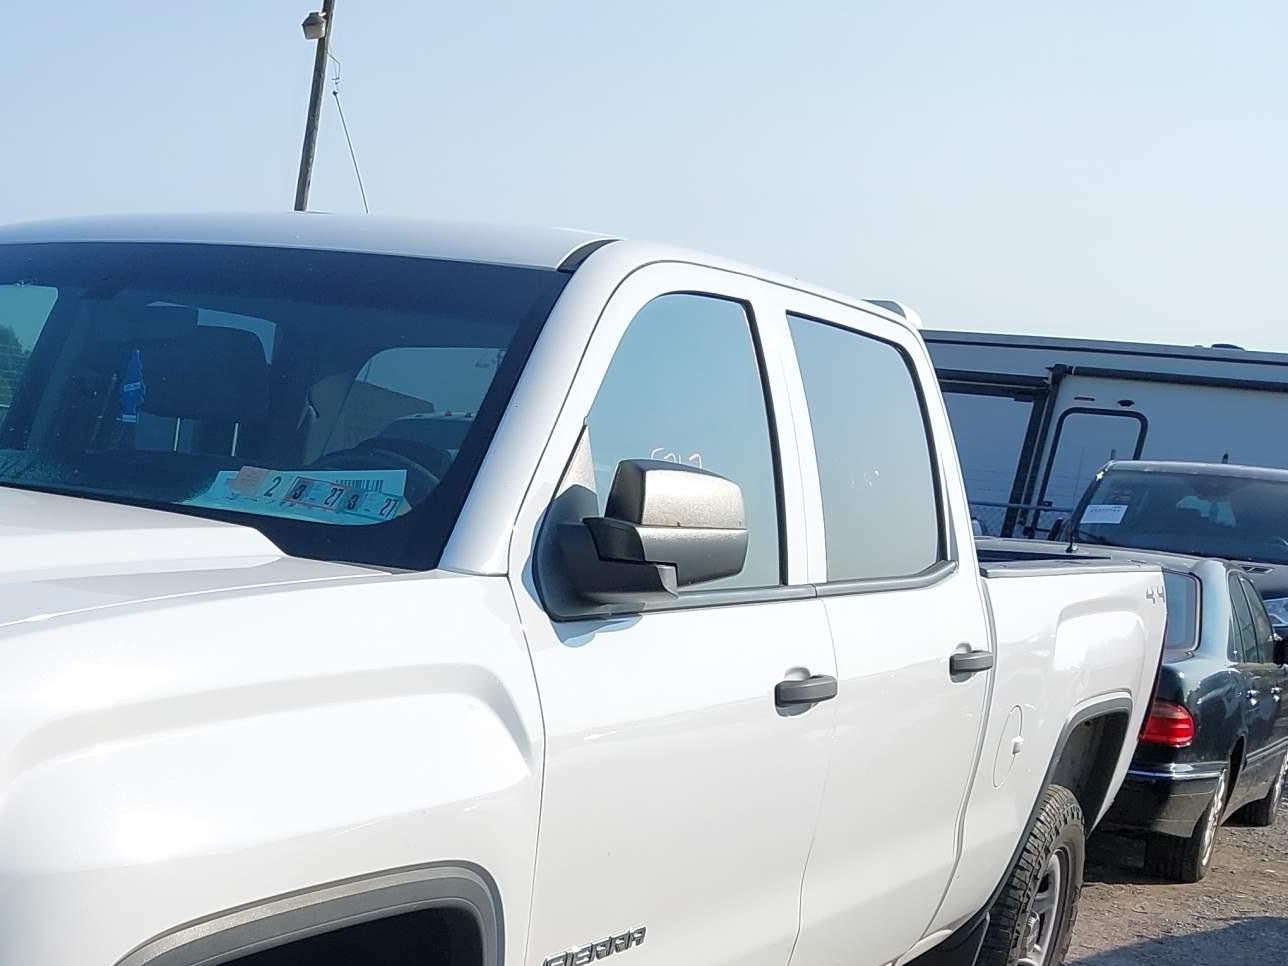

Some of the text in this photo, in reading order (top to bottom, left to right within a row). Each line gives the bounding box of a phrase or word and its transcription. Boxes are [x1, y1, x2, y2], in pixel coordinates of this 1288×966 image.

[264, 476, 282, 498] 2
[292, 483, 344, 507] 3 27
[346, 493, 399, 518] 3 27
